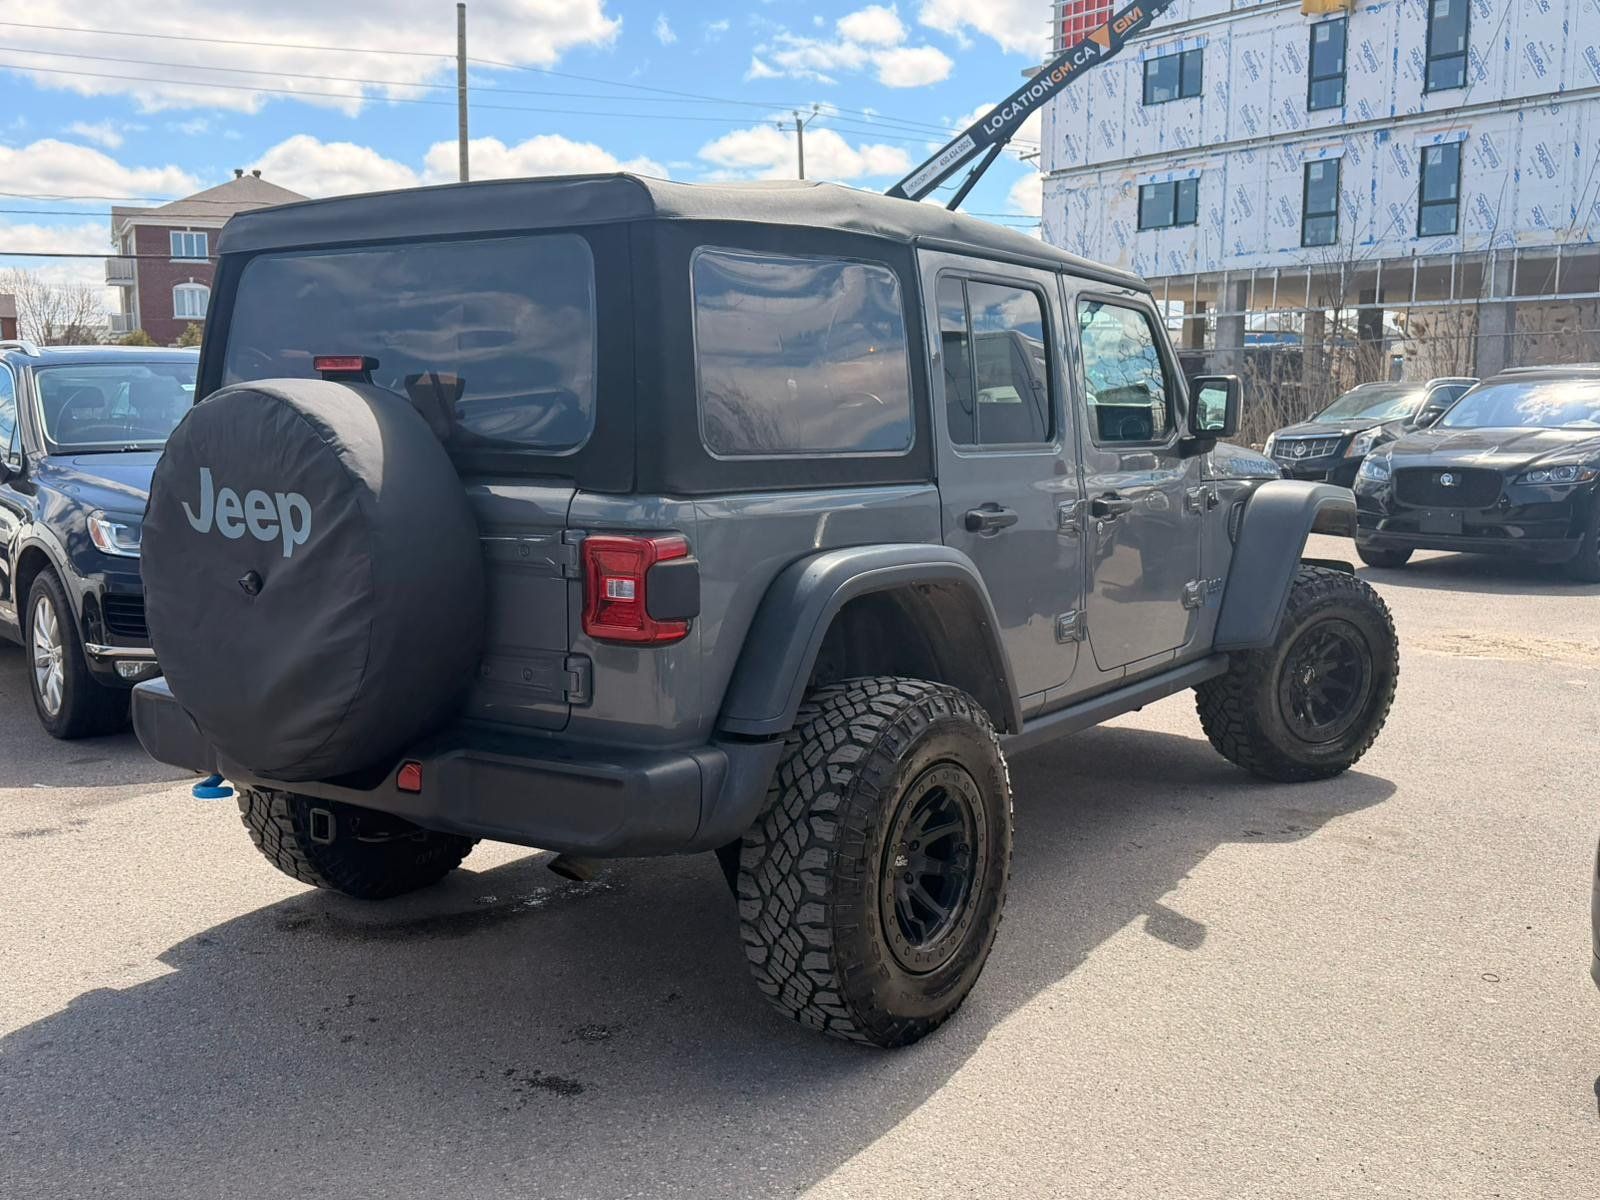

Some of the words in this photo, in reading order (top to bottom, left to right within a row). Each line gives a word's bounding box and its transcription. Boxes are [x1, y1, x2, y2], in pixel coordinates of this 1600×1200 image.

[1113, 6, 1144, 34] GM
[1526, 41, 1547, 77] GlasRoc
[1584, 45, 1600, 77] Glas
[983, 46, 1096, 135] LOCATIONGM.CA
[181, 466, 312, 558] Jeep
